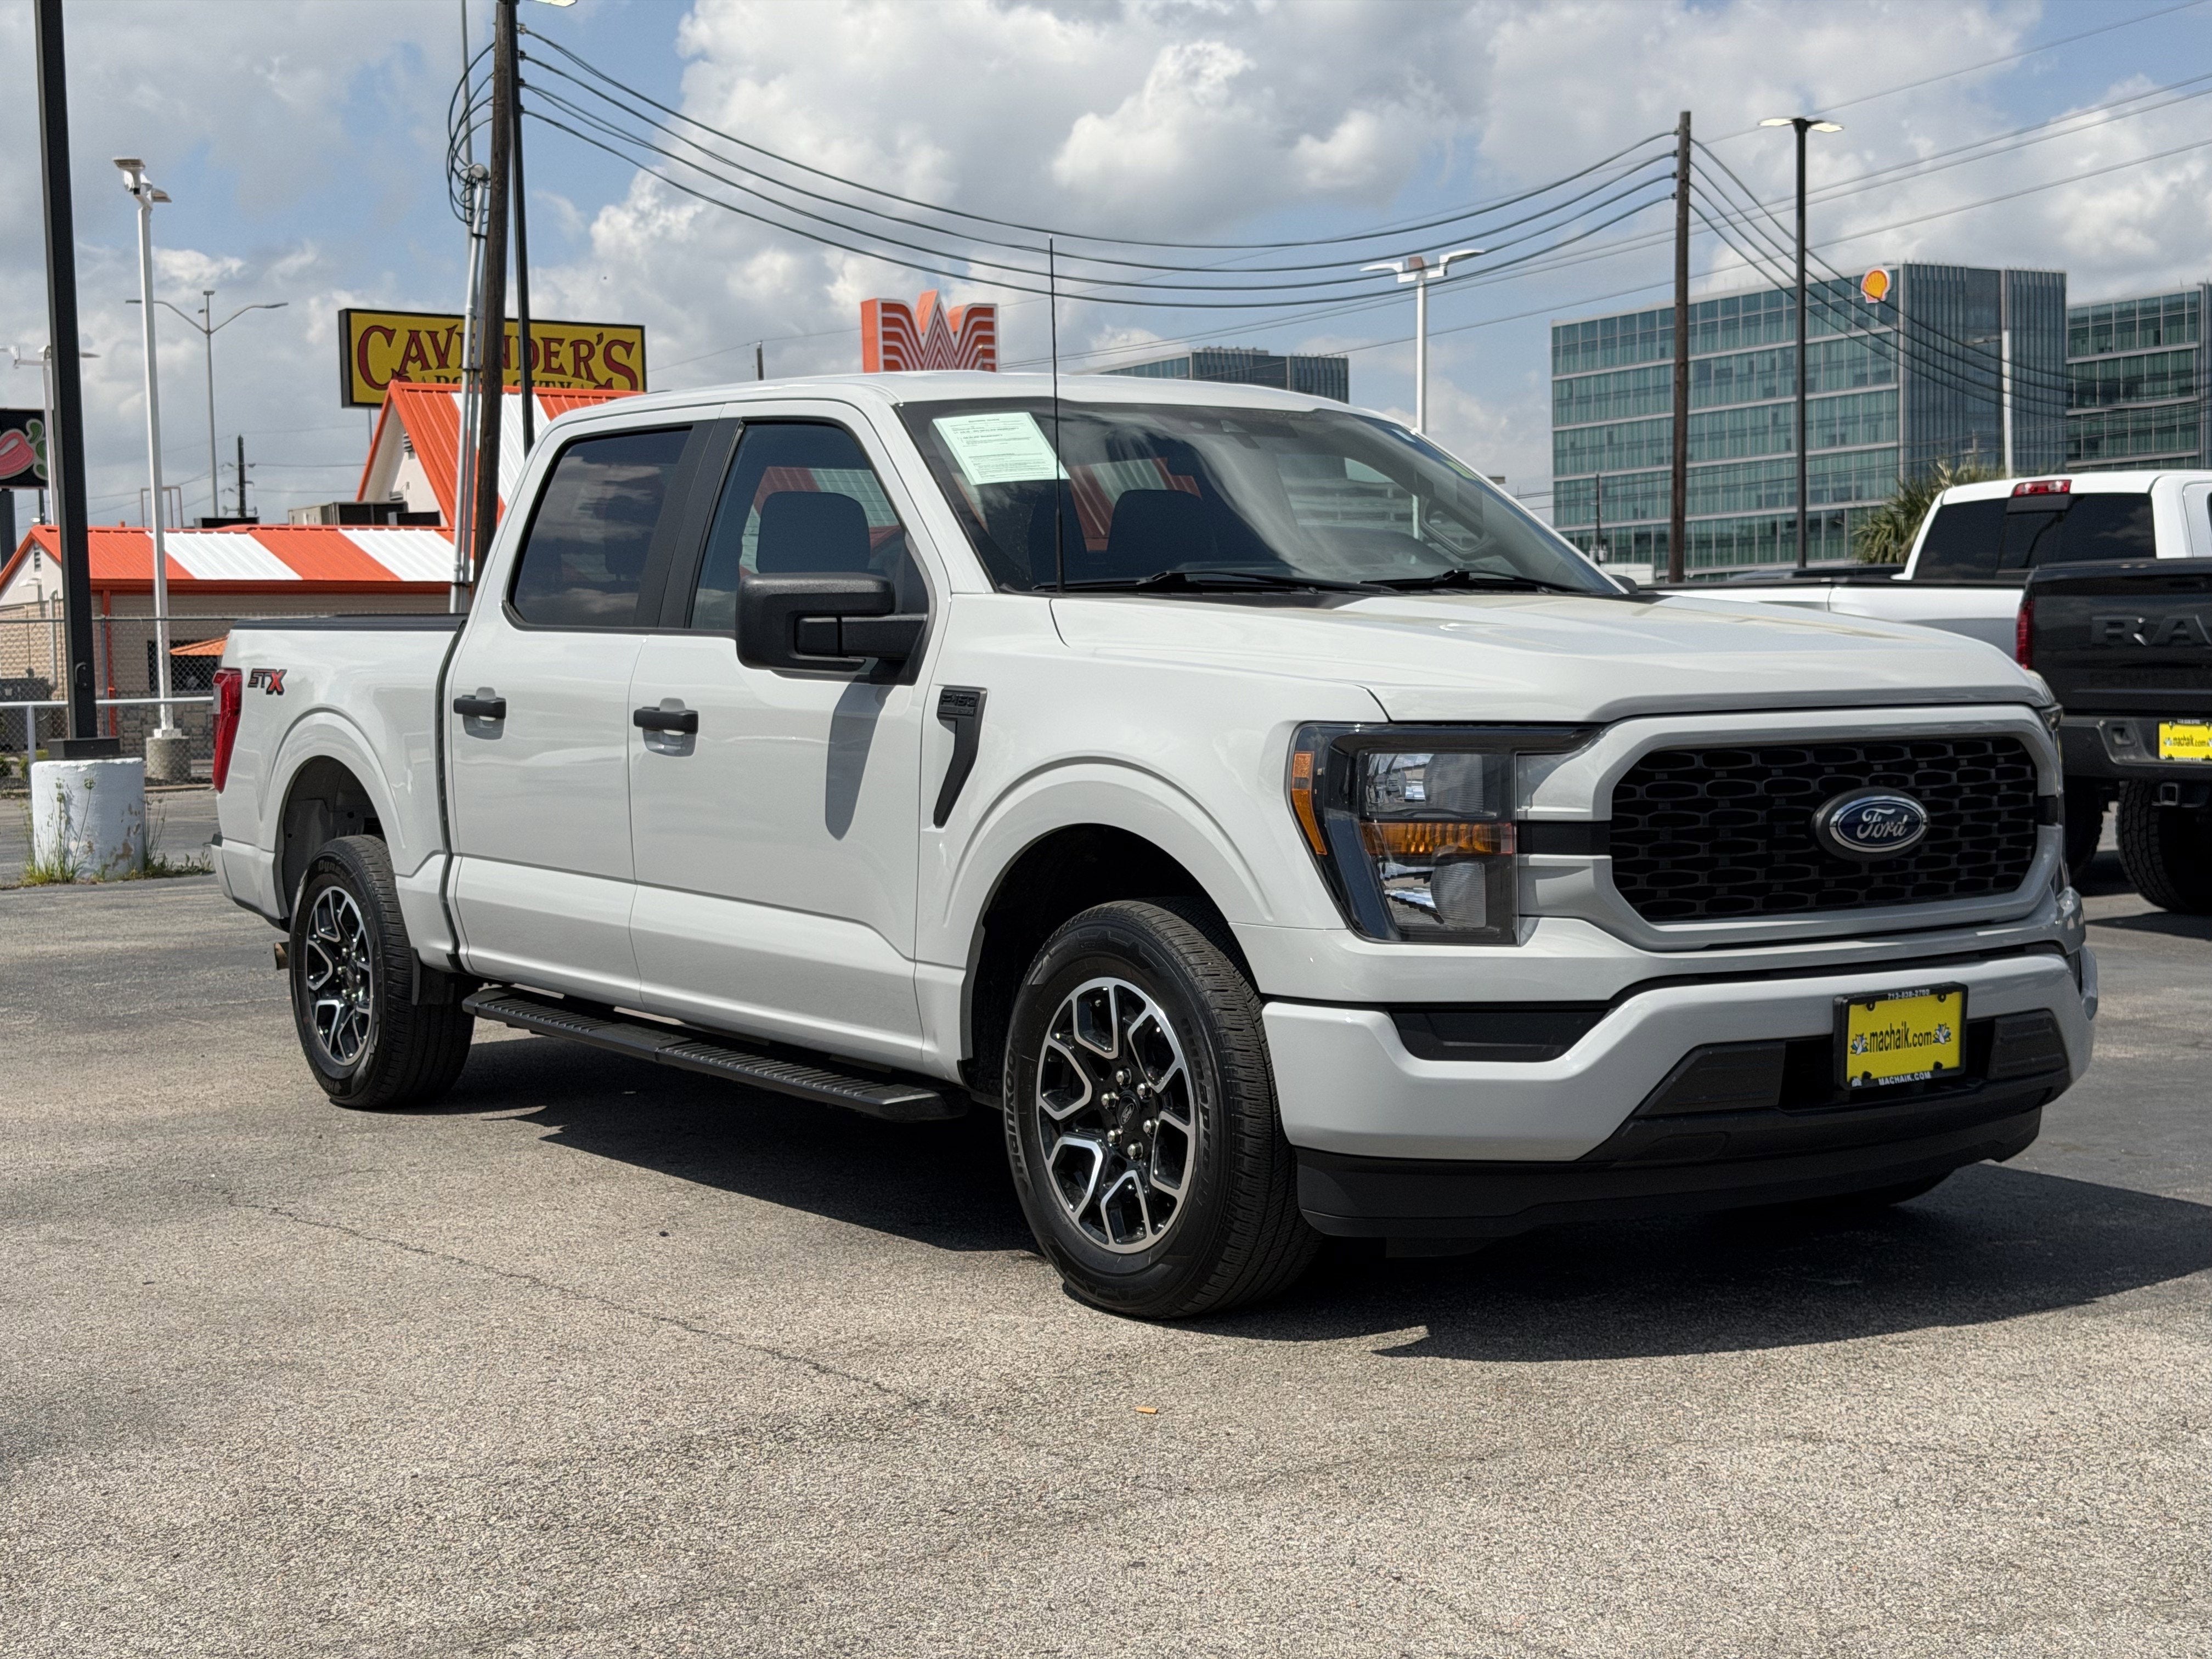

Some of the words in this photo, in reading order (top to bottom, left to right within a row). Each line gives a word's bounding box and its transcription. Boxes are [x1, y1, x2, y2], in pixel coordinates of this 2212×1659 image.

[357, 324, 638, 391] CAVDER'S
[247, 668, 287, 696] STX
[1857, 808, 1908, 839] Ford
[1869, 1021, 1932, 1053] machaik.com
[1878, 1071, 1932, 1086] MACHAIK.COM
